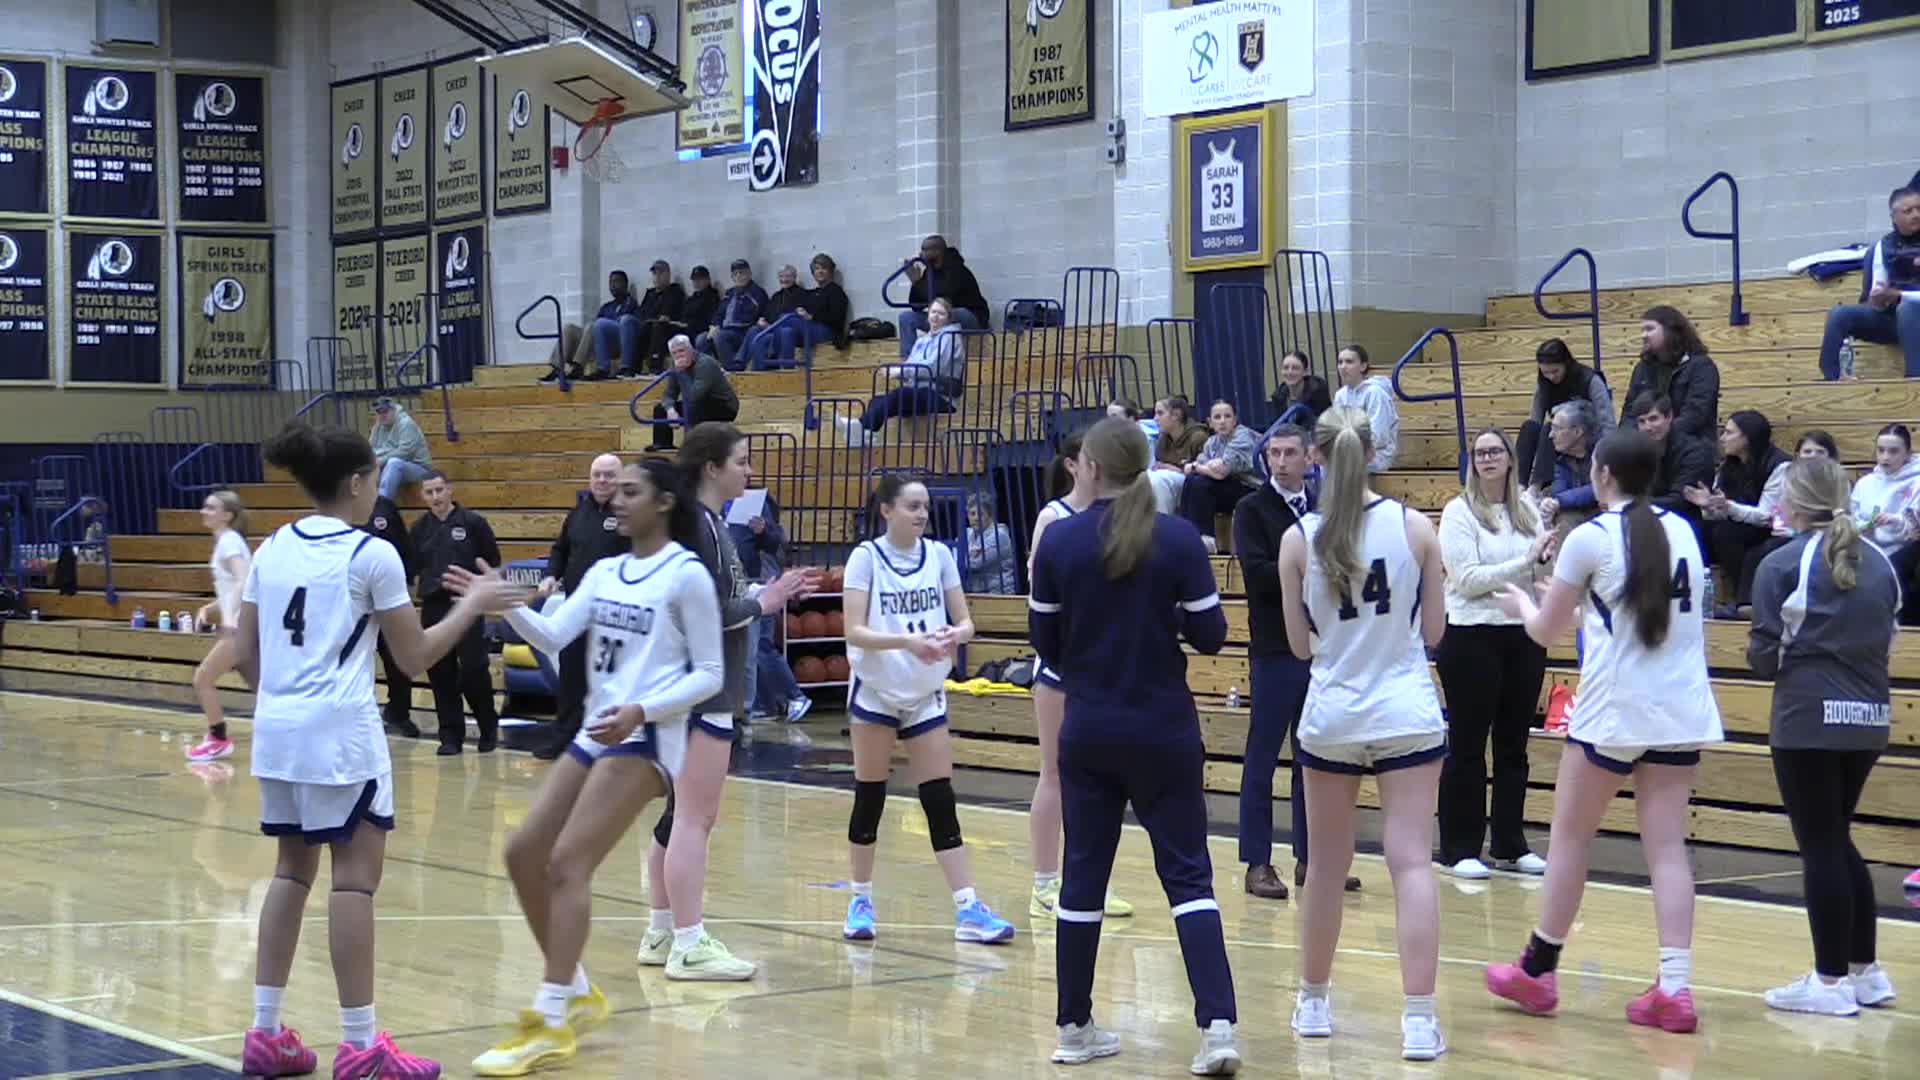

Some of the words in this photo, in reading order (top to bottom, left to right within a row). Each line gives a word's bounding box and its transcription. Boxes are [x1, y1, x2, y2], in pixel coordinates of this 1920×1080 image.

[1210, 1, 1241, 18] HEALTH
[1824, 5, 1861, 25] 2025
[1033, 44, 1063, 63] 1987
[1028, 65, 1065, 86] STATE
[1011, 86, 1084, 110] CHAMPIONS
[86, 129, 139, 145] LEAGUE
[196, 135, 248, 148] LEAGUE
[71, 142, 155, 158] CHAMPIONS
[182, 148, 263, 163] CHAMPIONS
[1206, 166, 1239, 181] SARAH
[498, 181, 544, 200] CHAMPIONS
[1211, 182, 1235, 210] 33
[436, 191, 479, 210] CHAMPIONS
[1209, 212, 1236, 227] BEHN
[208, 246, 245, 258] GIRLS
[187, 261, 229, 272] SPRING
[231, 261, 267, 273] TRACK
[76, 293, 113, 307] STATE
[116, 295, 157, 308] RELAY
[75, 307, 159, 322] CHAMPIONS
[211, 331, 245, 343] 1998
[193, 347, 263, 360] ALL-STATE
[188, 363, 269, 377] CHAMPIONS
[1338, 558, 1391, 621] 14
[879, 587, 941, 616] FOXBOR
[282, 586, 308, 647] 4
